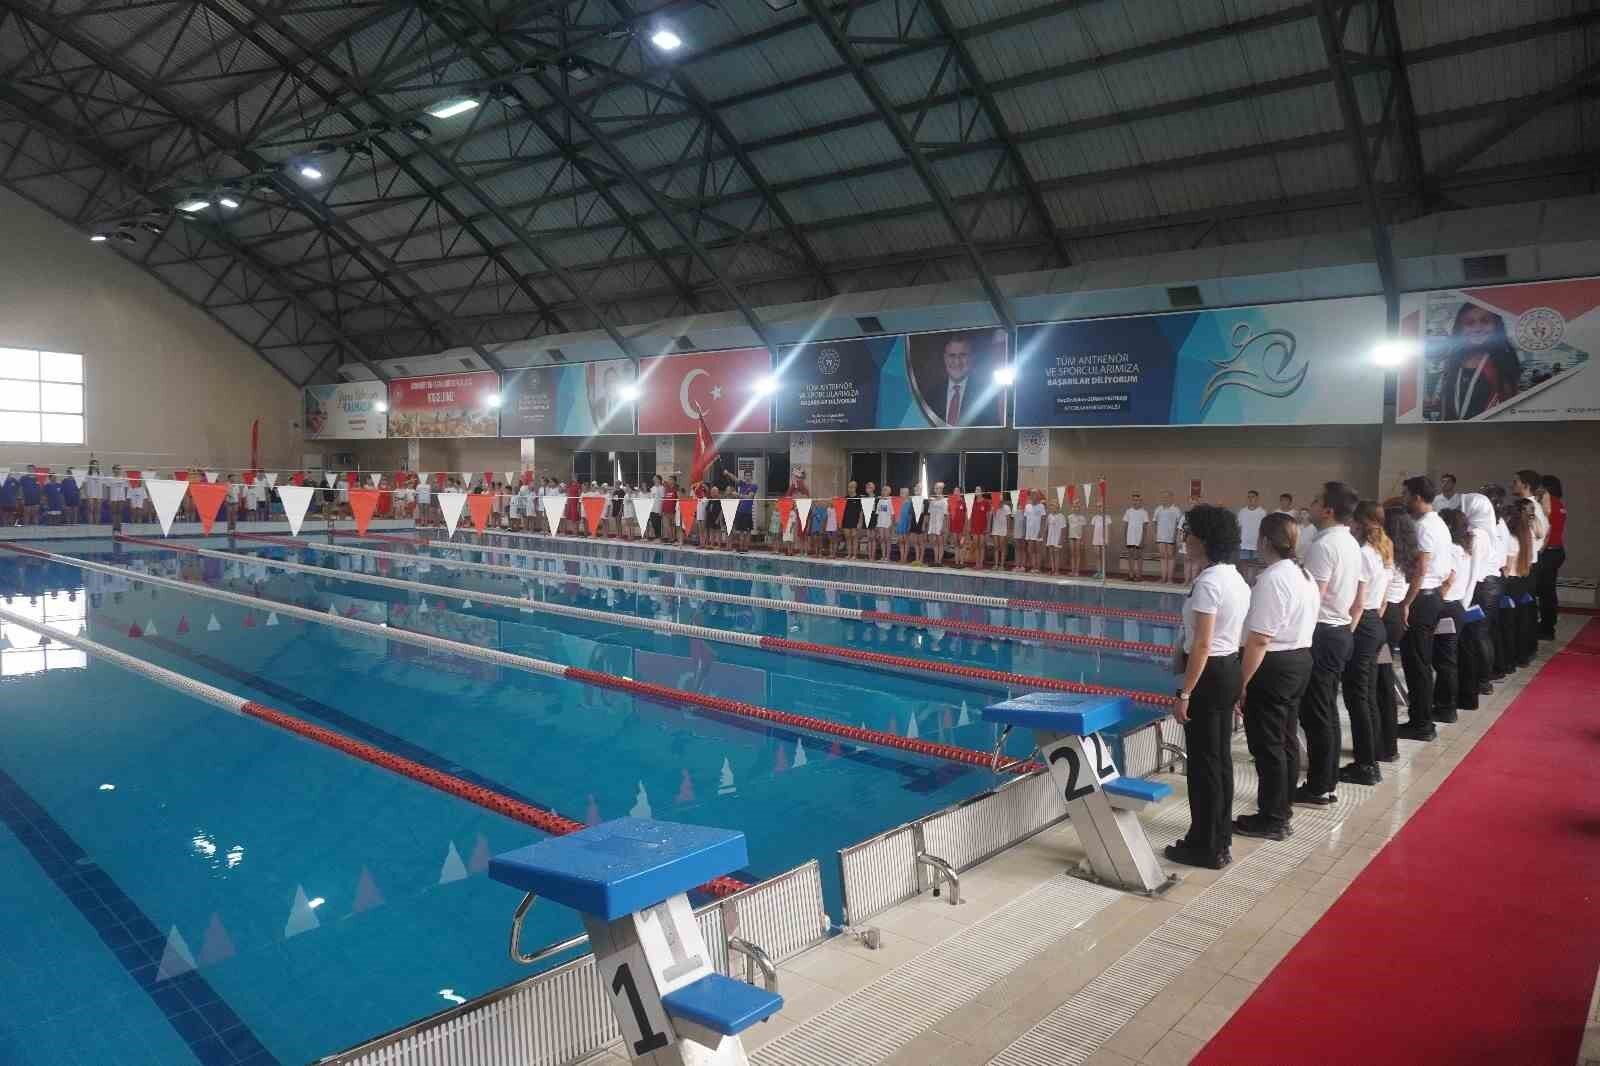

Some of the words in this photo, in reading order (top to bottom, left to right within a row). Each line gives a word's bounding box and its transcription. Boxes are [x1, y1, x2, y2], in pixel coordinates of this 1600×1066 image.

[1046, 366, 1056, 377] VE
[1057, 364, 1140, 377] SPORCULARIMIZA
[1056, 355, 1077, 367] TÜM
[1049, 747, 1095, 801] 2
[1080, 732, 1115, 779] 2
[640, 903, 703, 982] 1
[612, 962, 668, 1056] 1
